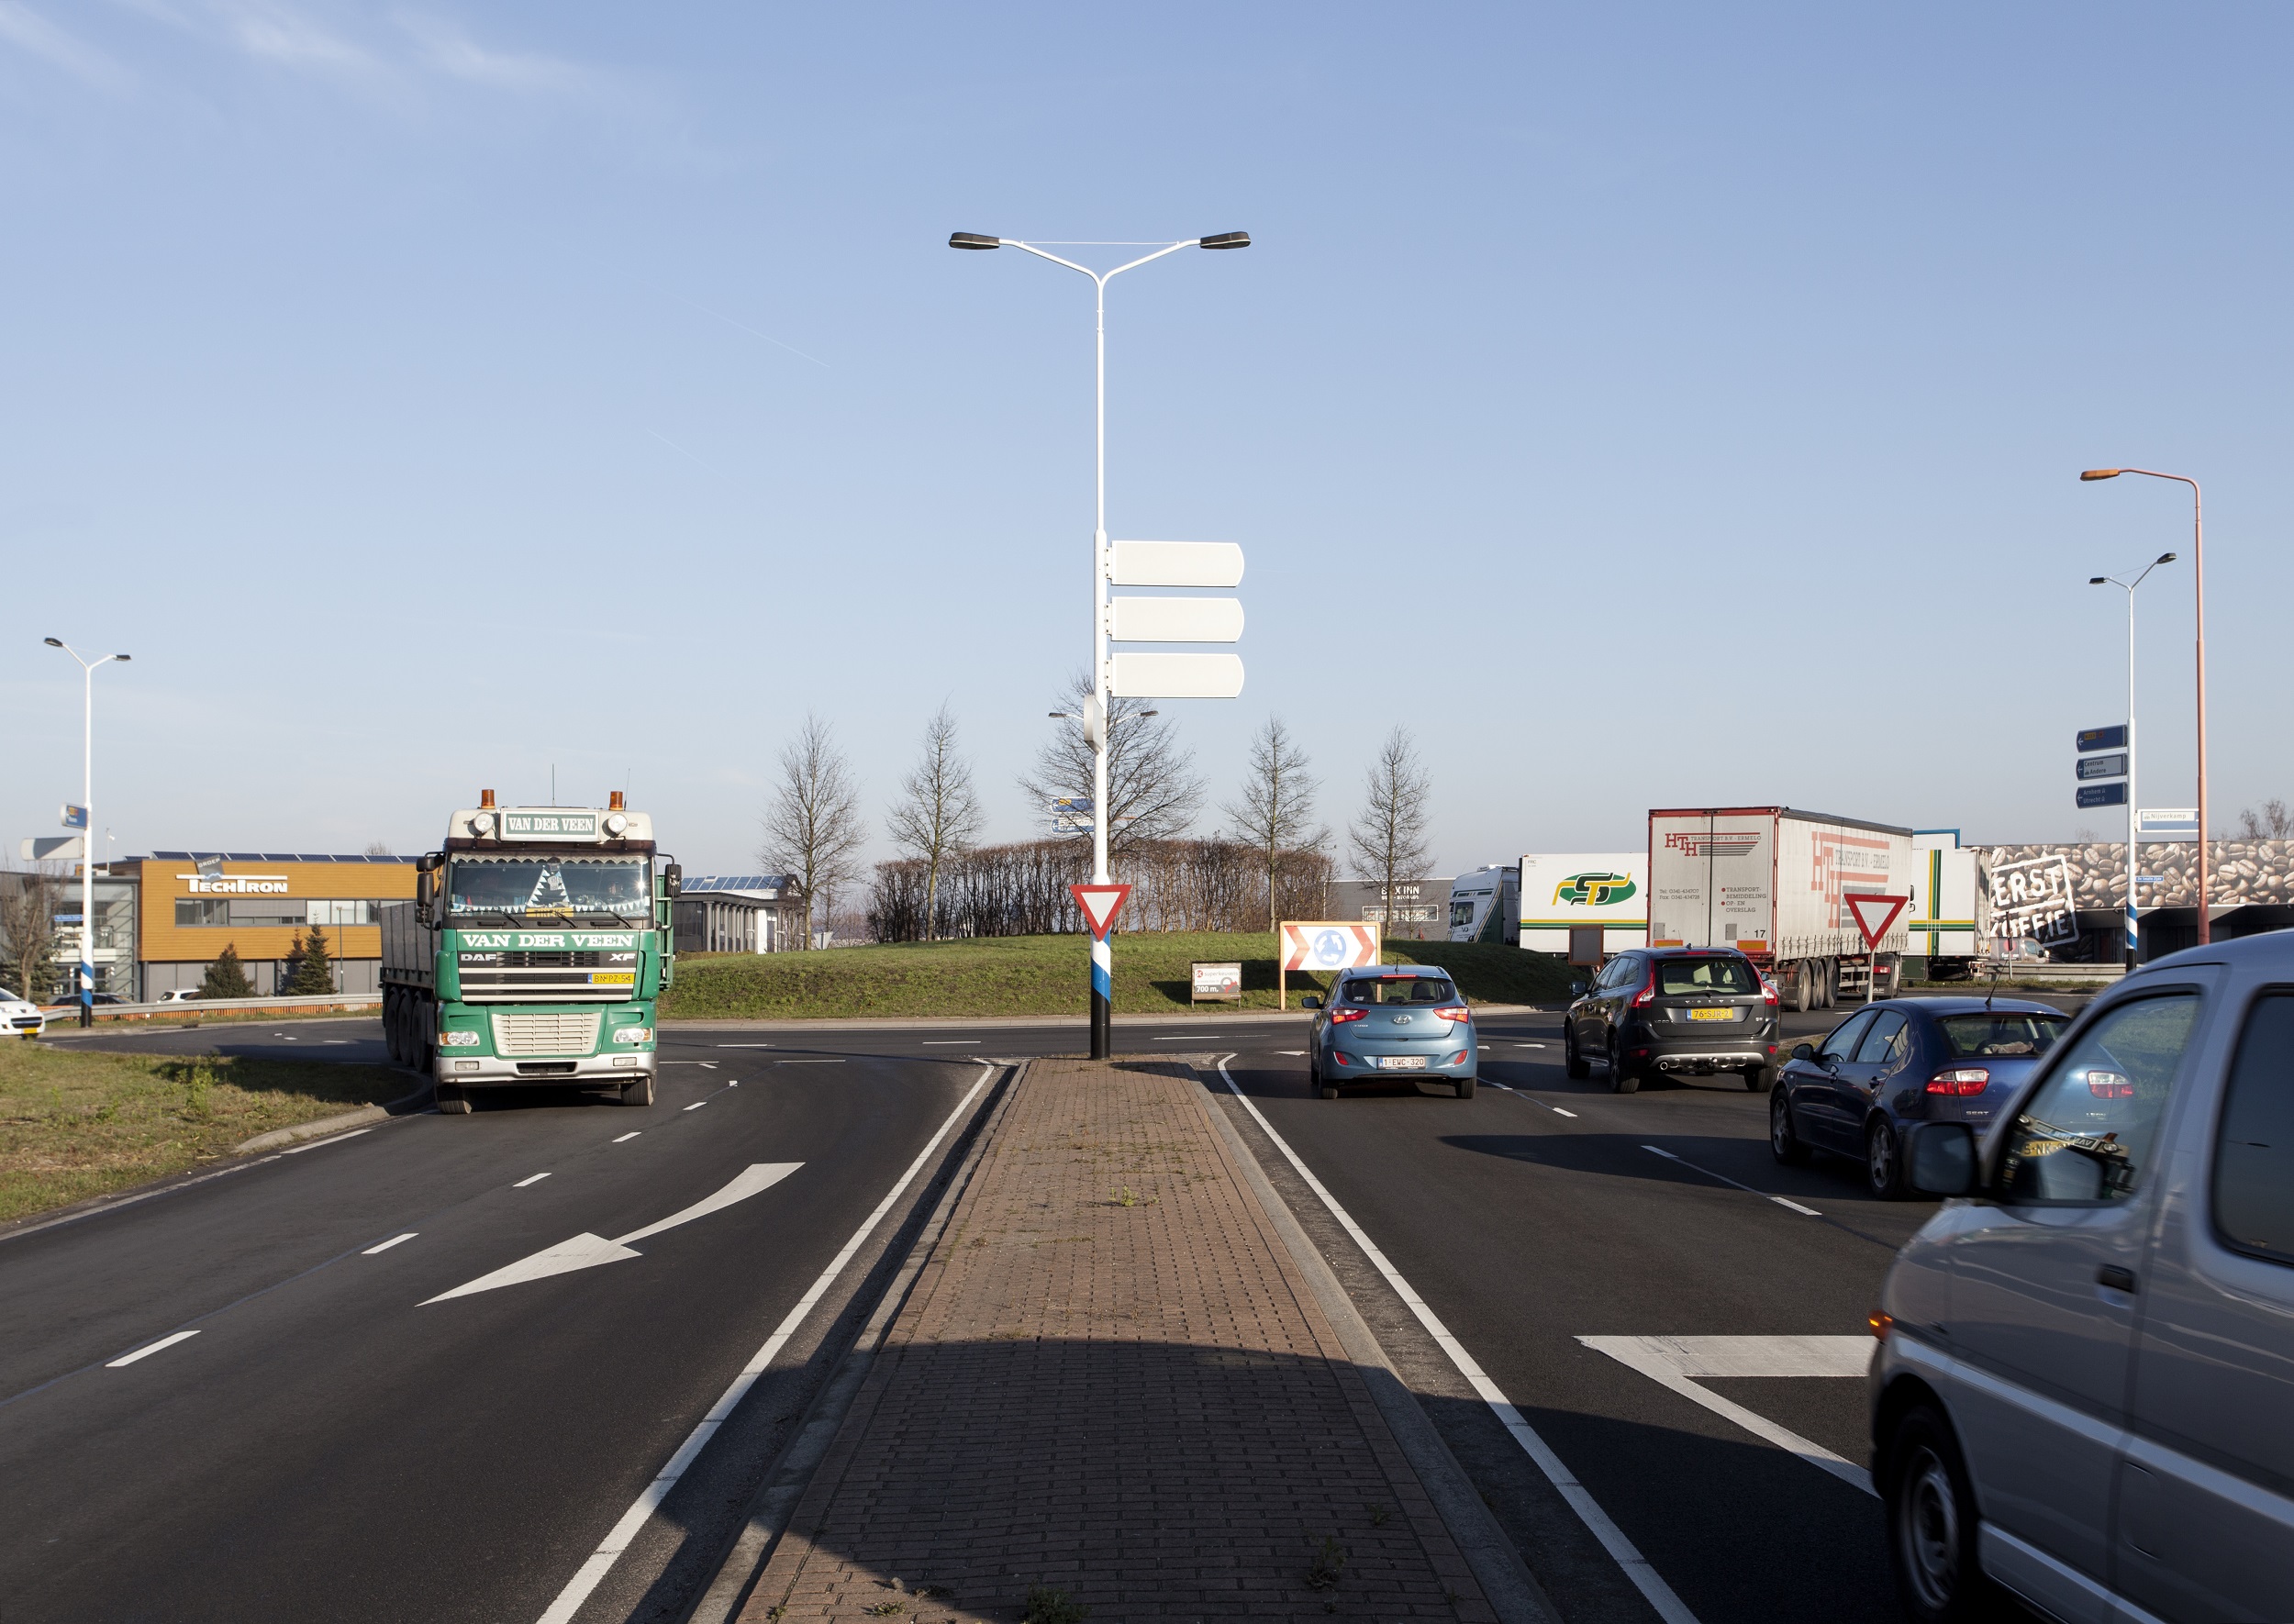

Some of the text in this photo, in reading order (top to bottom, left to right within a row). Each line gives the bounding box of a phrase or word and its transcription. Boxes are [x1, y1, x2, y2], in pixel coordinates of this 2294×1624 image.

[507, 817, 595, 832] VAN DER VEEN
[1665, 833, 1698, 856] HTH
[197, 858, 220, 868] GROEP
[1835, 850, 1861, 867] TRANSPORT
[1873, 853, 1889, 870] ERMELO
[1811, 831, 1840, 929] HTH
[1381, 885, 1420, 895] BX INN
[1754, 929, 1766, 938] 17
[462, 934, 635, 947] VAN DER VEEN
[461, 953, 497, 962] DAF
